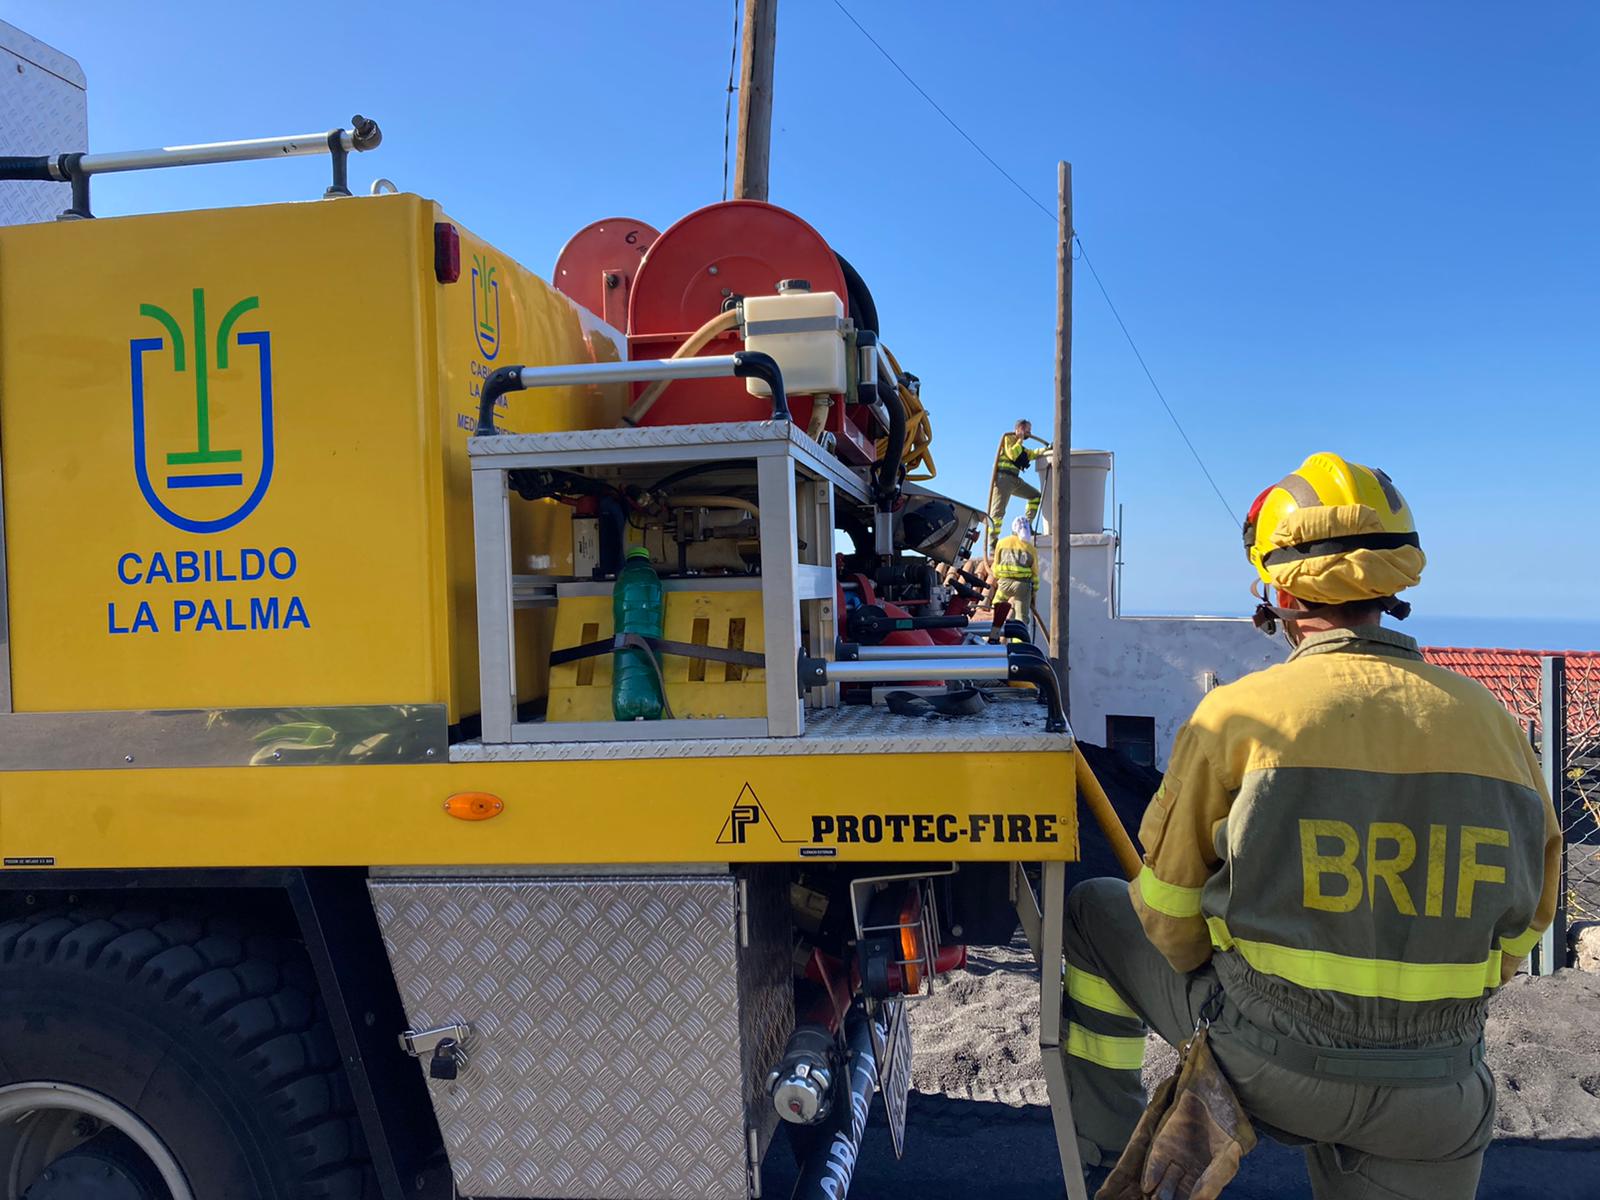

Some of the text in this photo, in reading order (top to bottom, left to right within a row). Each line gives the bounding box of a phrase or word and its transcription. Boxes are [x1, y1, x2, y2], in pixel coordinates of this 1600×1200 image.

[117, 547, 297, 585] CABILDO
[108, 596, 311, 634] LA PALMA
[811, 814, 1059, 843] PROTEC-FIRE
[1298, 818, 1510, 919] BRIF
